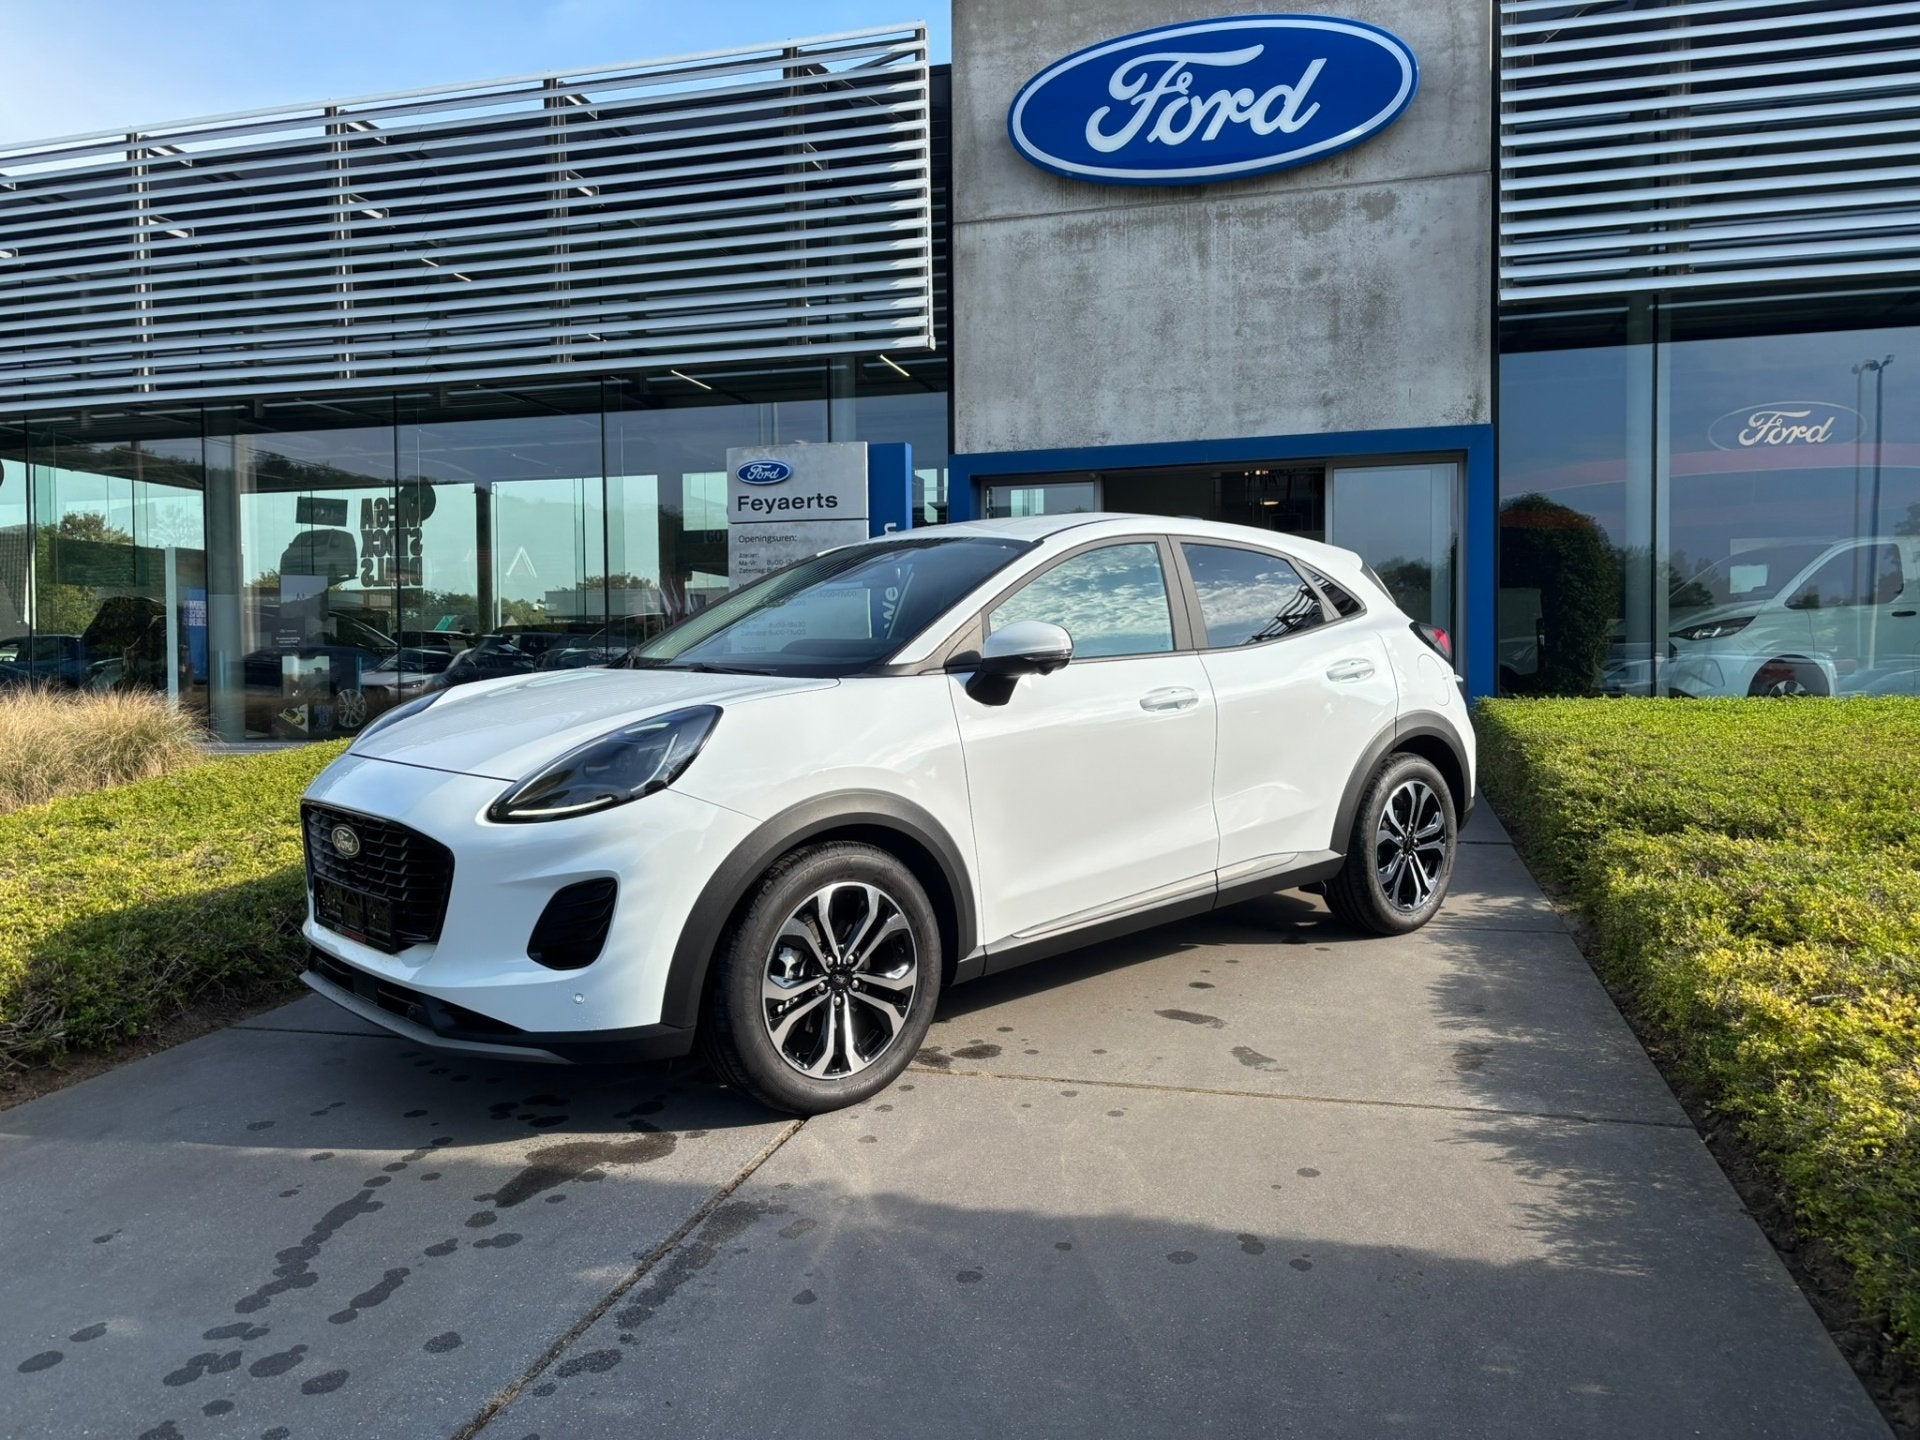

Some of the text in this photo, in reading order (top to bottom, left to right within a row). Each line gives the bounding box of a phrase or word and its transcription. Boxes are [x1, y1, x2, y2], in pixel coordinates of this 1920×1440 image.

[1085, 44, 1327, 153] Ford
[1738, 411, 1835, 446] Ford
[746, 465, 779, 480] Ford
[737, 493, 838, 514] Feyaerts
[738, 534, 798, 543] Openingsuren:
